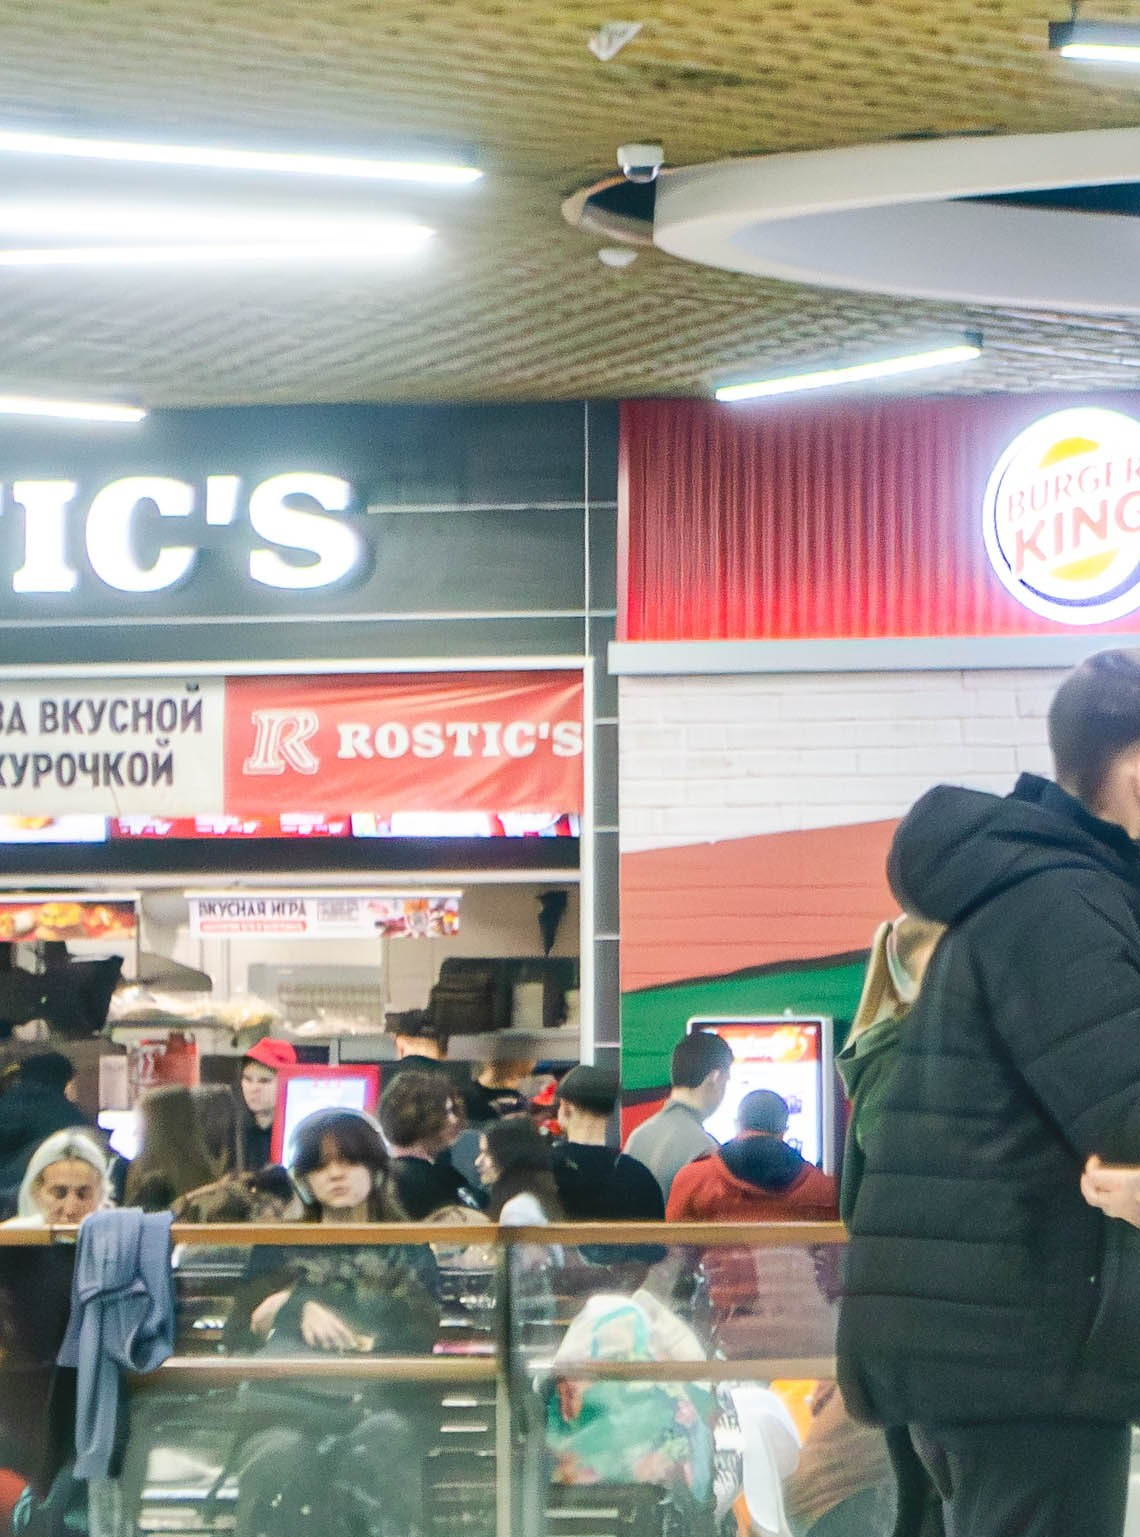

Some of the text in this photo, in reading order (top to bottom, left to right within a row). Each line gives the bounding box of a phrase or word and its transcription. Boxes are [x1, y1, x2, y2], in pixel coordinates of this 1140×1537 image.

[0, 473, 362, 592] IC'S
[40, 683, 203, 734] ВКУСНОЙ
[0, 738, 173, 787] УРОЧКОЙ
[336, 721, 582, 758] ROSTIC'S
[199, 900, 265, 918] ВКУСНАЯ
[271, 899, 307, 916] ИГРА
